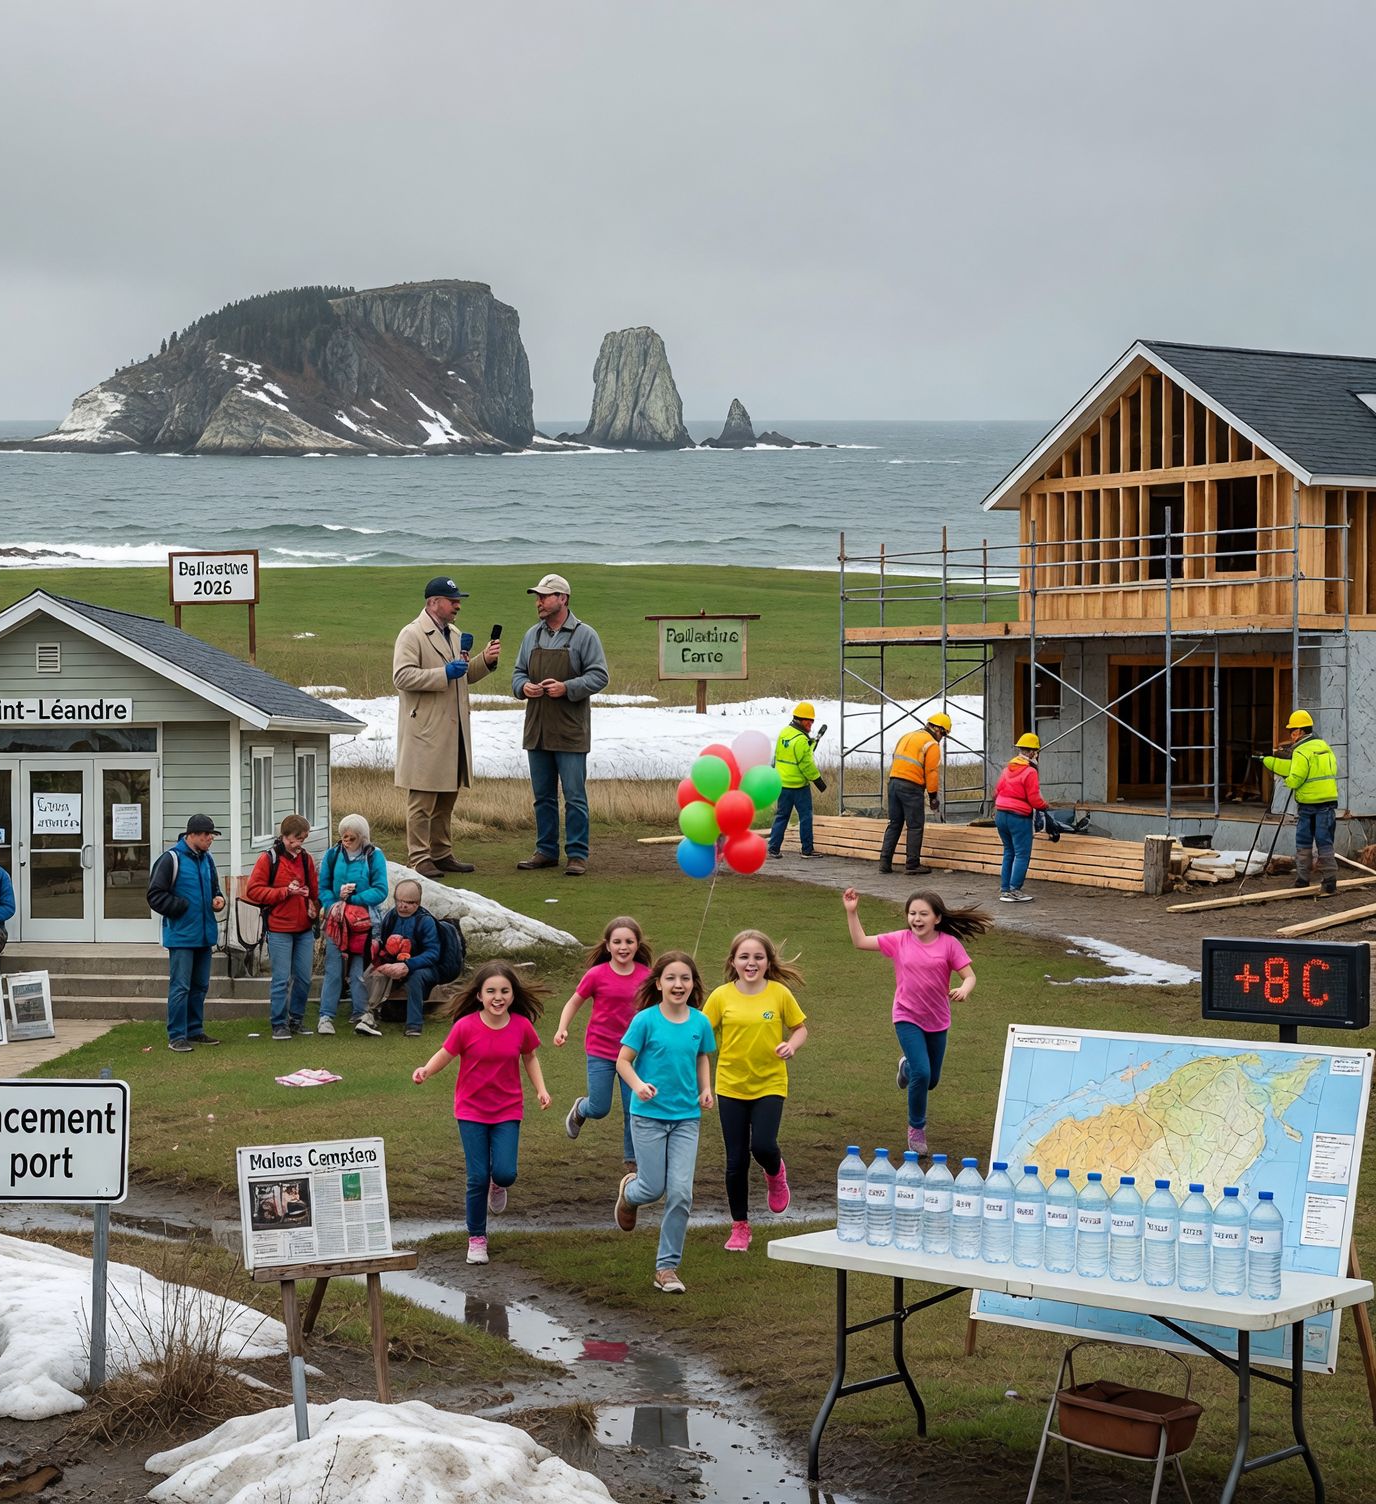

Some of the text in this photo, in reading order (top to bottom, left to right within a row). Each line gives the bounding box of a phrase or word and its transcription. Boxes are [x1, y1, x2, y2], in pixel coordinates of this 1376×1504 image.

[193, 580, 232, 595] 2026
[1233, 957, 1330, 1007] +8 C
[10, 1147, 73, 1187] port
